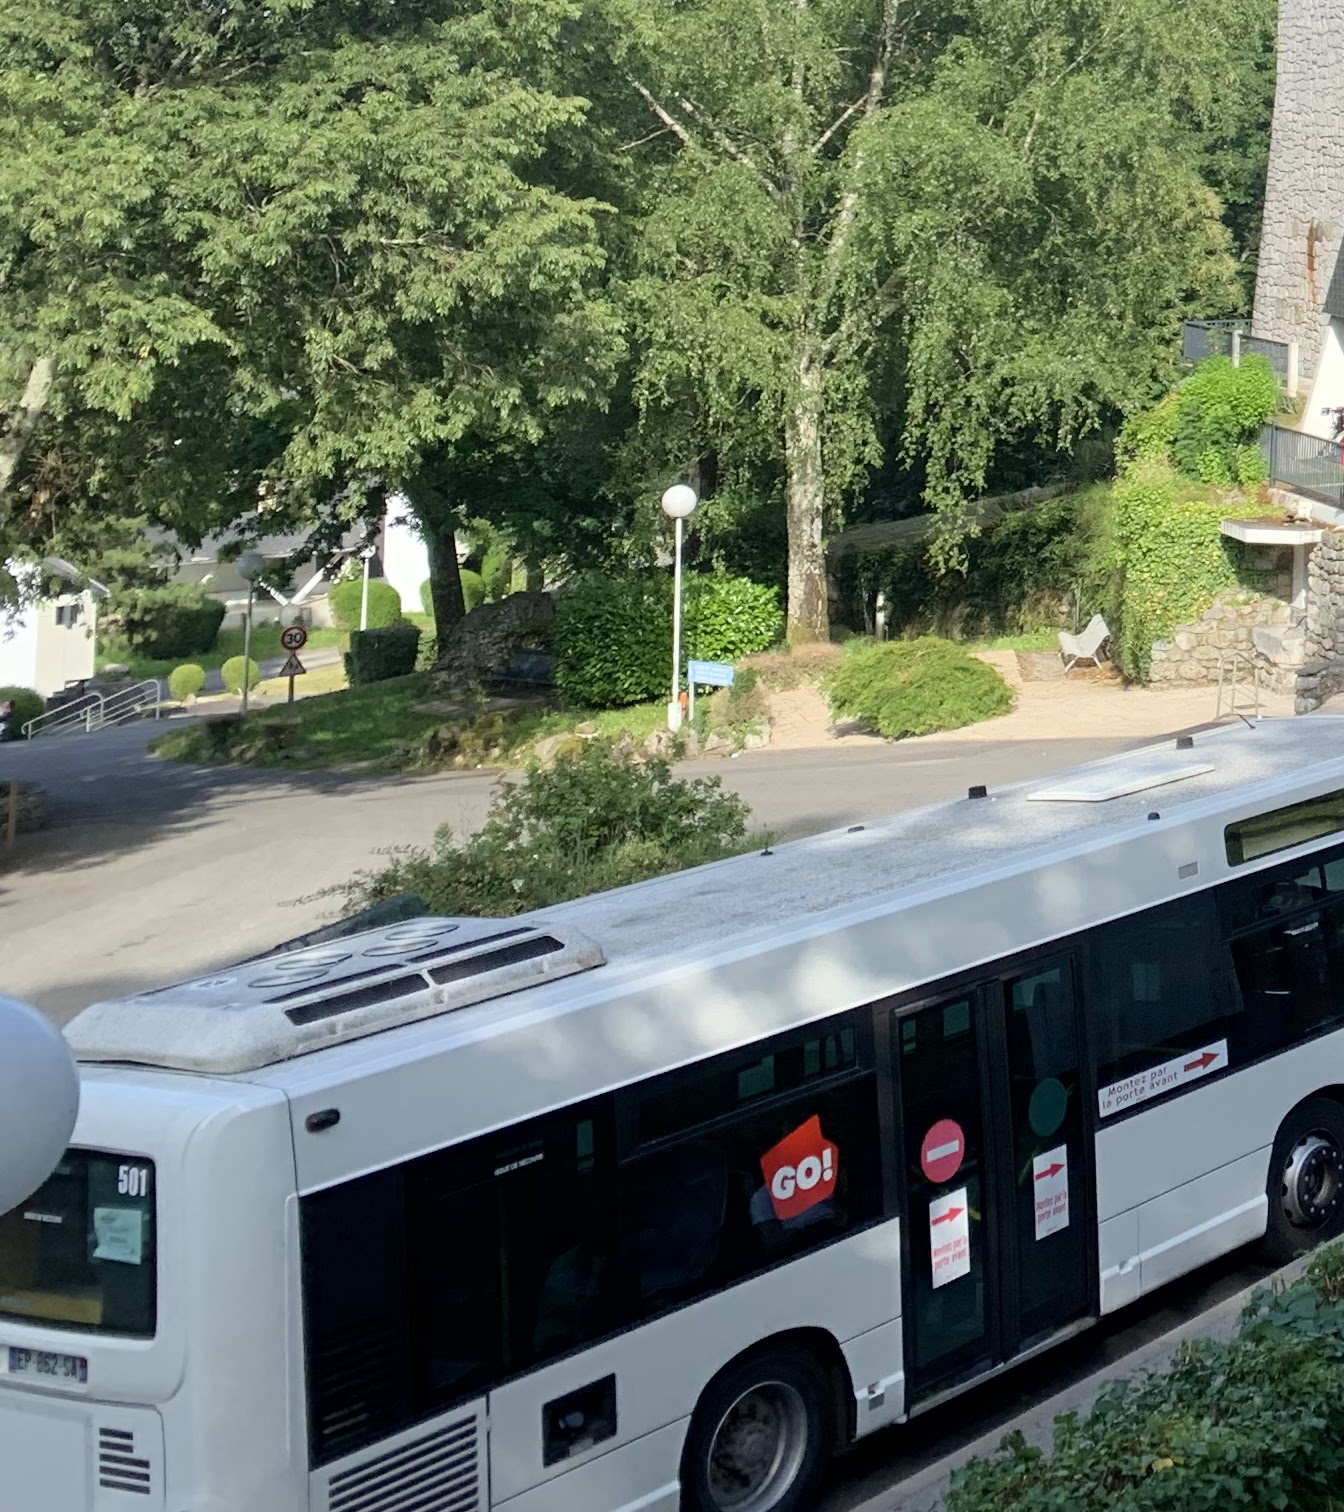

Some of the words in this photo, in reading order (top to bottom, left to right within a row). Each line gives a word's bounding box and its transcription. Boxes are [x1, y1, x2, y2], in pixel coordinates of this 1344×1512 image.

[286, 631, 302, 645] 30
[1102, 1099, 1112, 1110] la
[1116, 1086, 1146, 1106] porte
[1149, 1072, 1179, 1090] avant
[1107, 1074, 1147, 1097] Montez
[1150, 1066, 1168, 1082] par
[117, 1164, 148, 1197] 501
[771, 1147, 833, 1200] GO!
